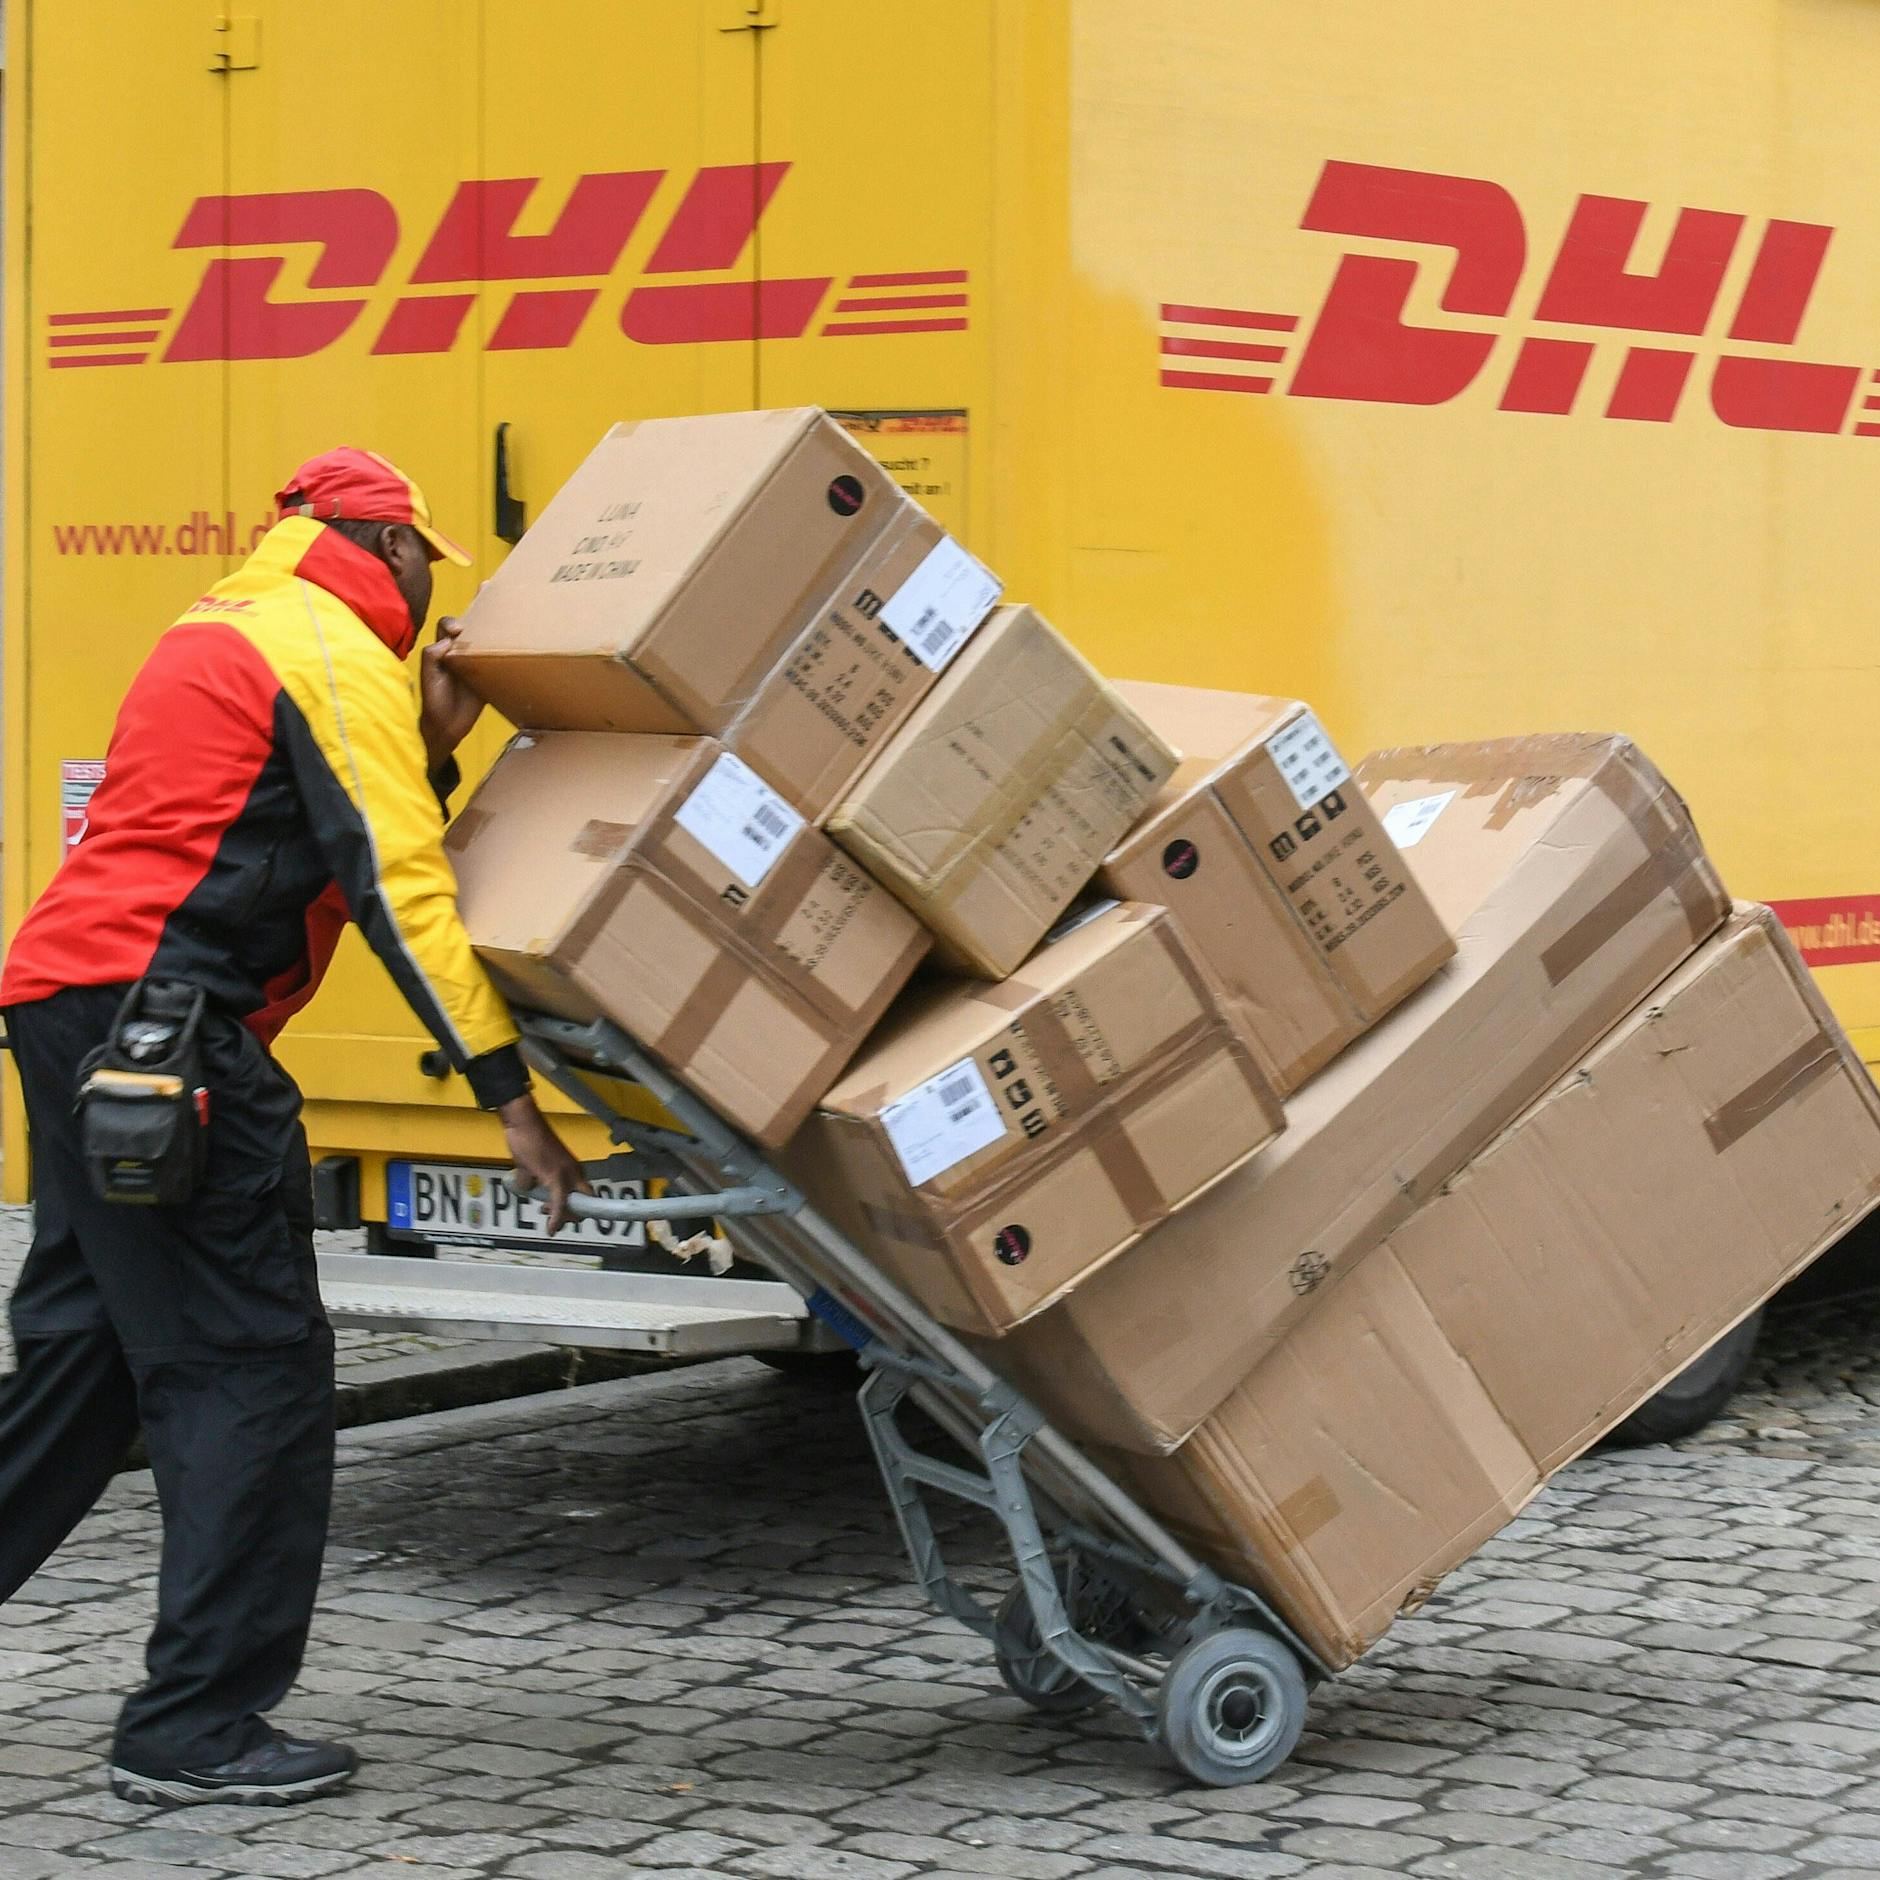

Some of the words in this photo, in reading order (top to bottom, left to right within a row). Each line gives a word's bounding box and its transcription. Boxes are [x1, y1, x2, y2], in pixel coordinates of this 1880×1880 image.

[160, 161, 836, 363] DHL
[1286, 159, 1863, 435] DHL
[415, 1172, 462, 1224] BN
